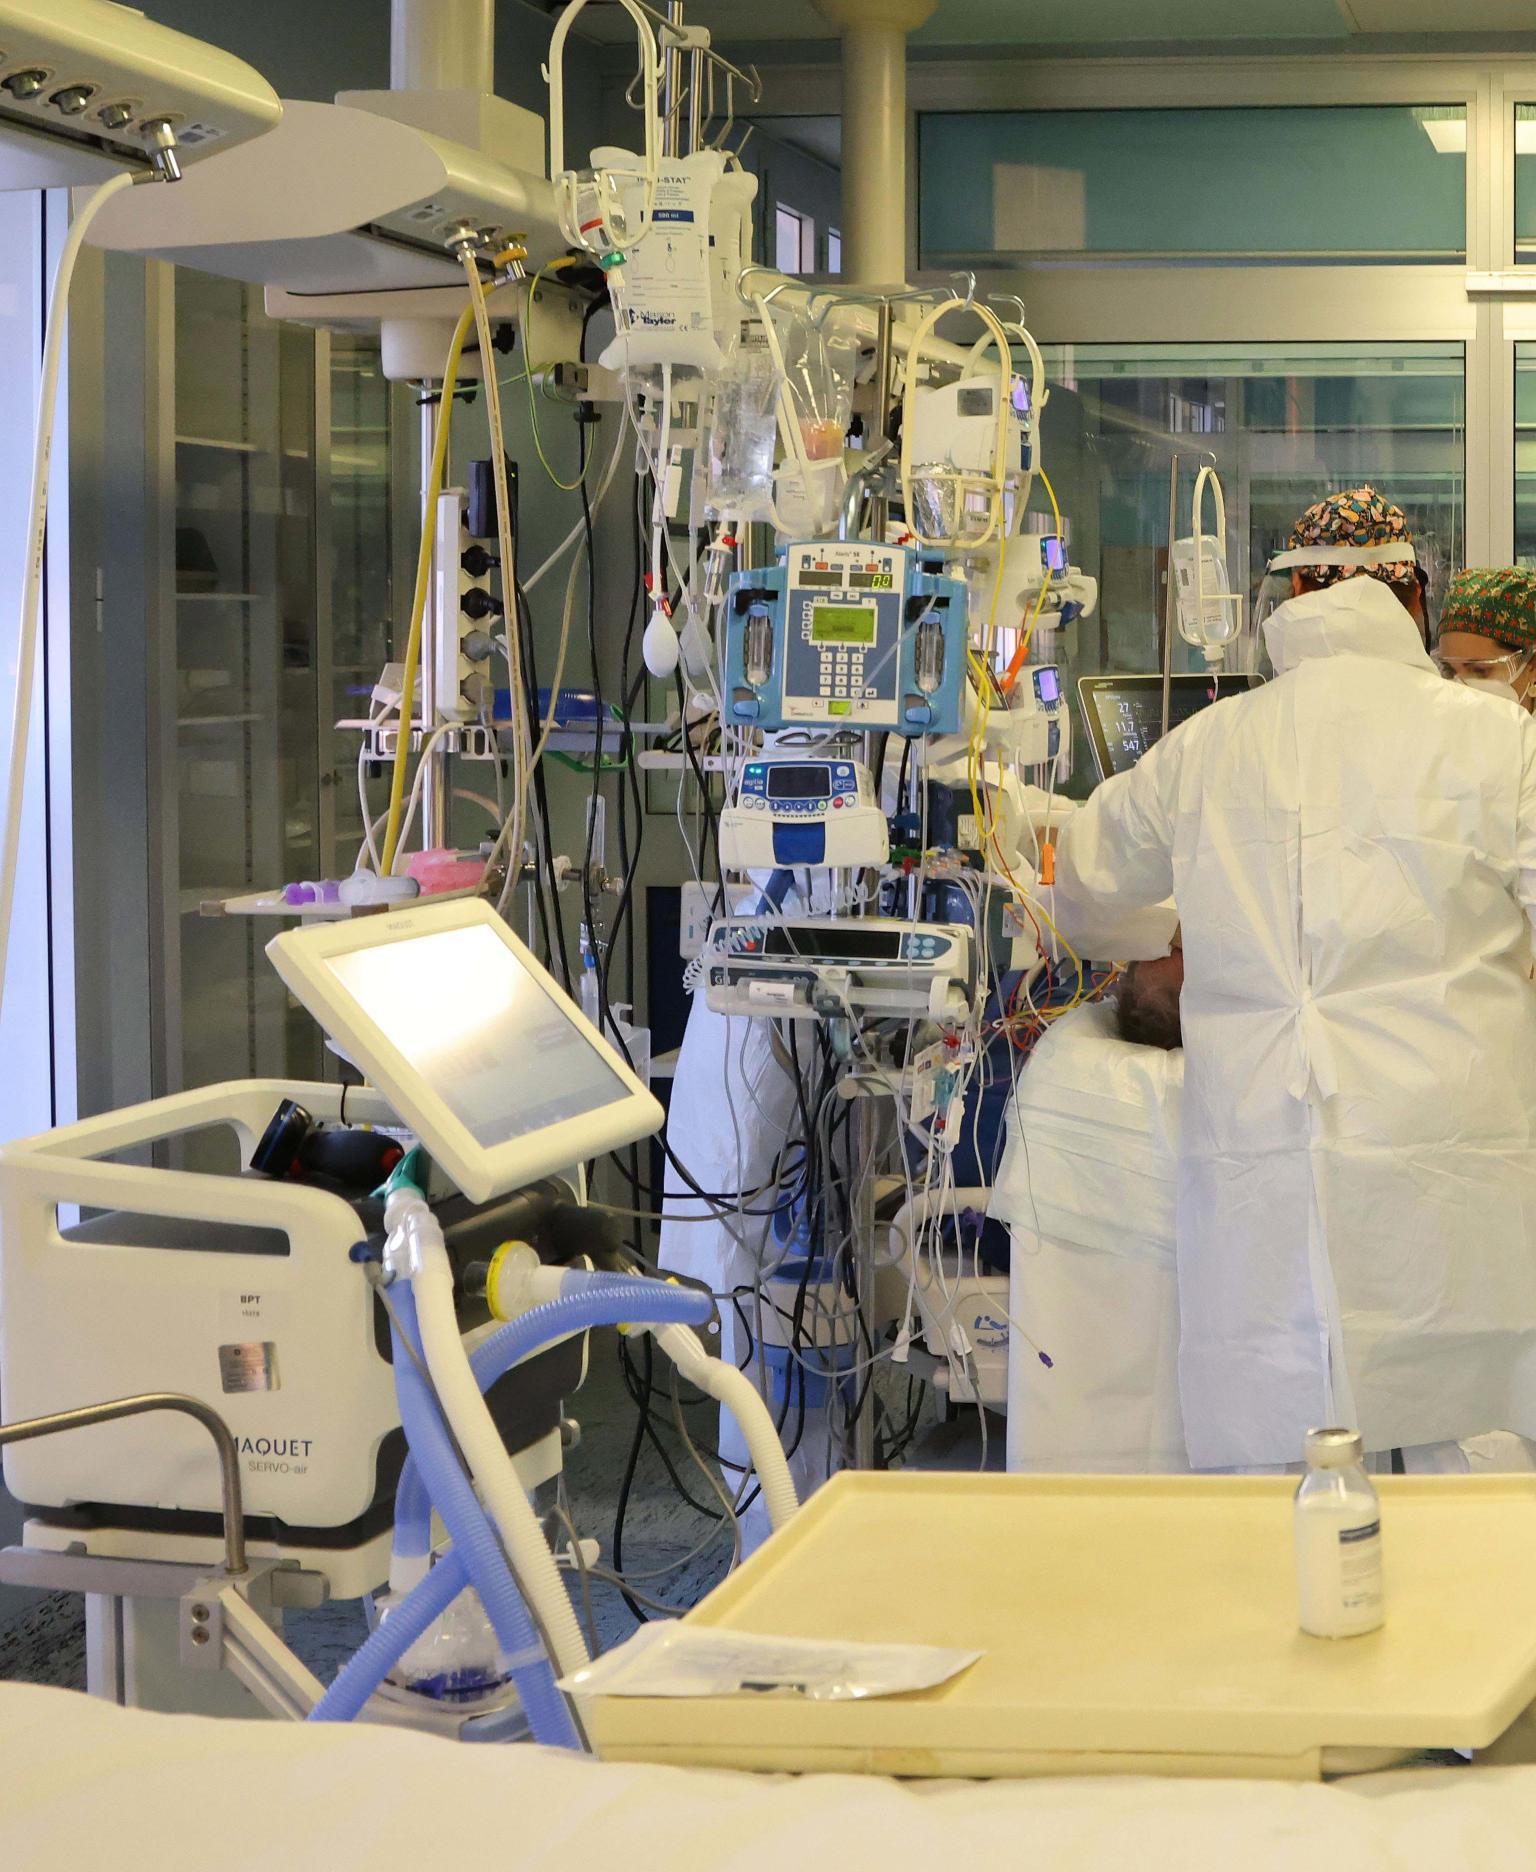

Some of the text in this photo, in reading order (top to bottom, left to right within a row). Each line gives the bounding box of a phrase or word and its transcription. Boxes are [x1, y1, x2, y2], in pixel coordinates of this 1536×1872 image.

[1118, 702, 1129, 713] 27
[1116, 721, 1134, 733] 11.7
[1122, 740, 1139, 751] 547
[248, 1460, 308, 1474] SERVO-air
